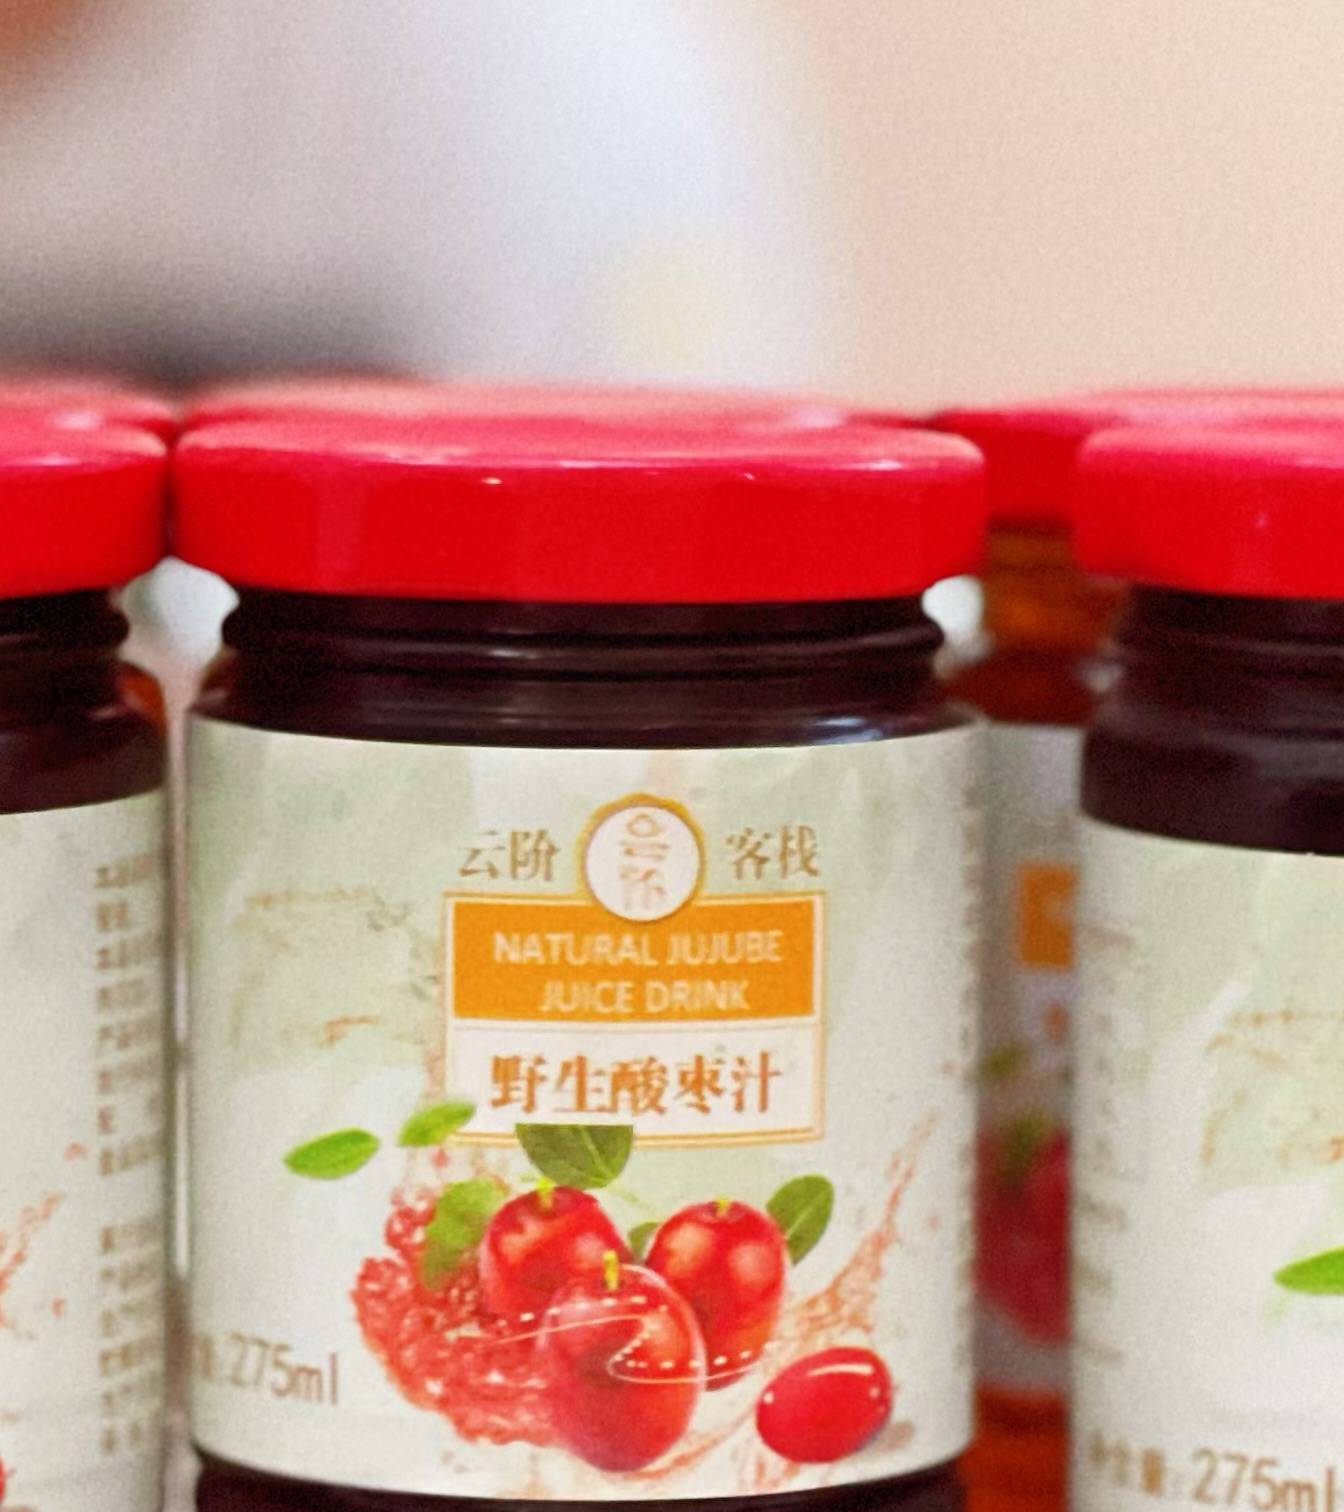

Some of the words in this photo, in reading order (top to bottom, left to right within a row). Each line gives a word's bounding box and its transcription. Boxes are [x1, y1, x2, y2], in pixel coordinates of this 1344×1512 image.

[457, 828, 562, 883] 云阶
[725, 824, 822, 881] 客栈
[491, 931, 660, 966] NATURAL
[665, 930, 784, 964] JUJUBE
[540, 980, 634, 1014] JUICE
[643, 980, 752, 1014] DRINK
[490, 1050, 783, 1117] 野生酸枣汁
